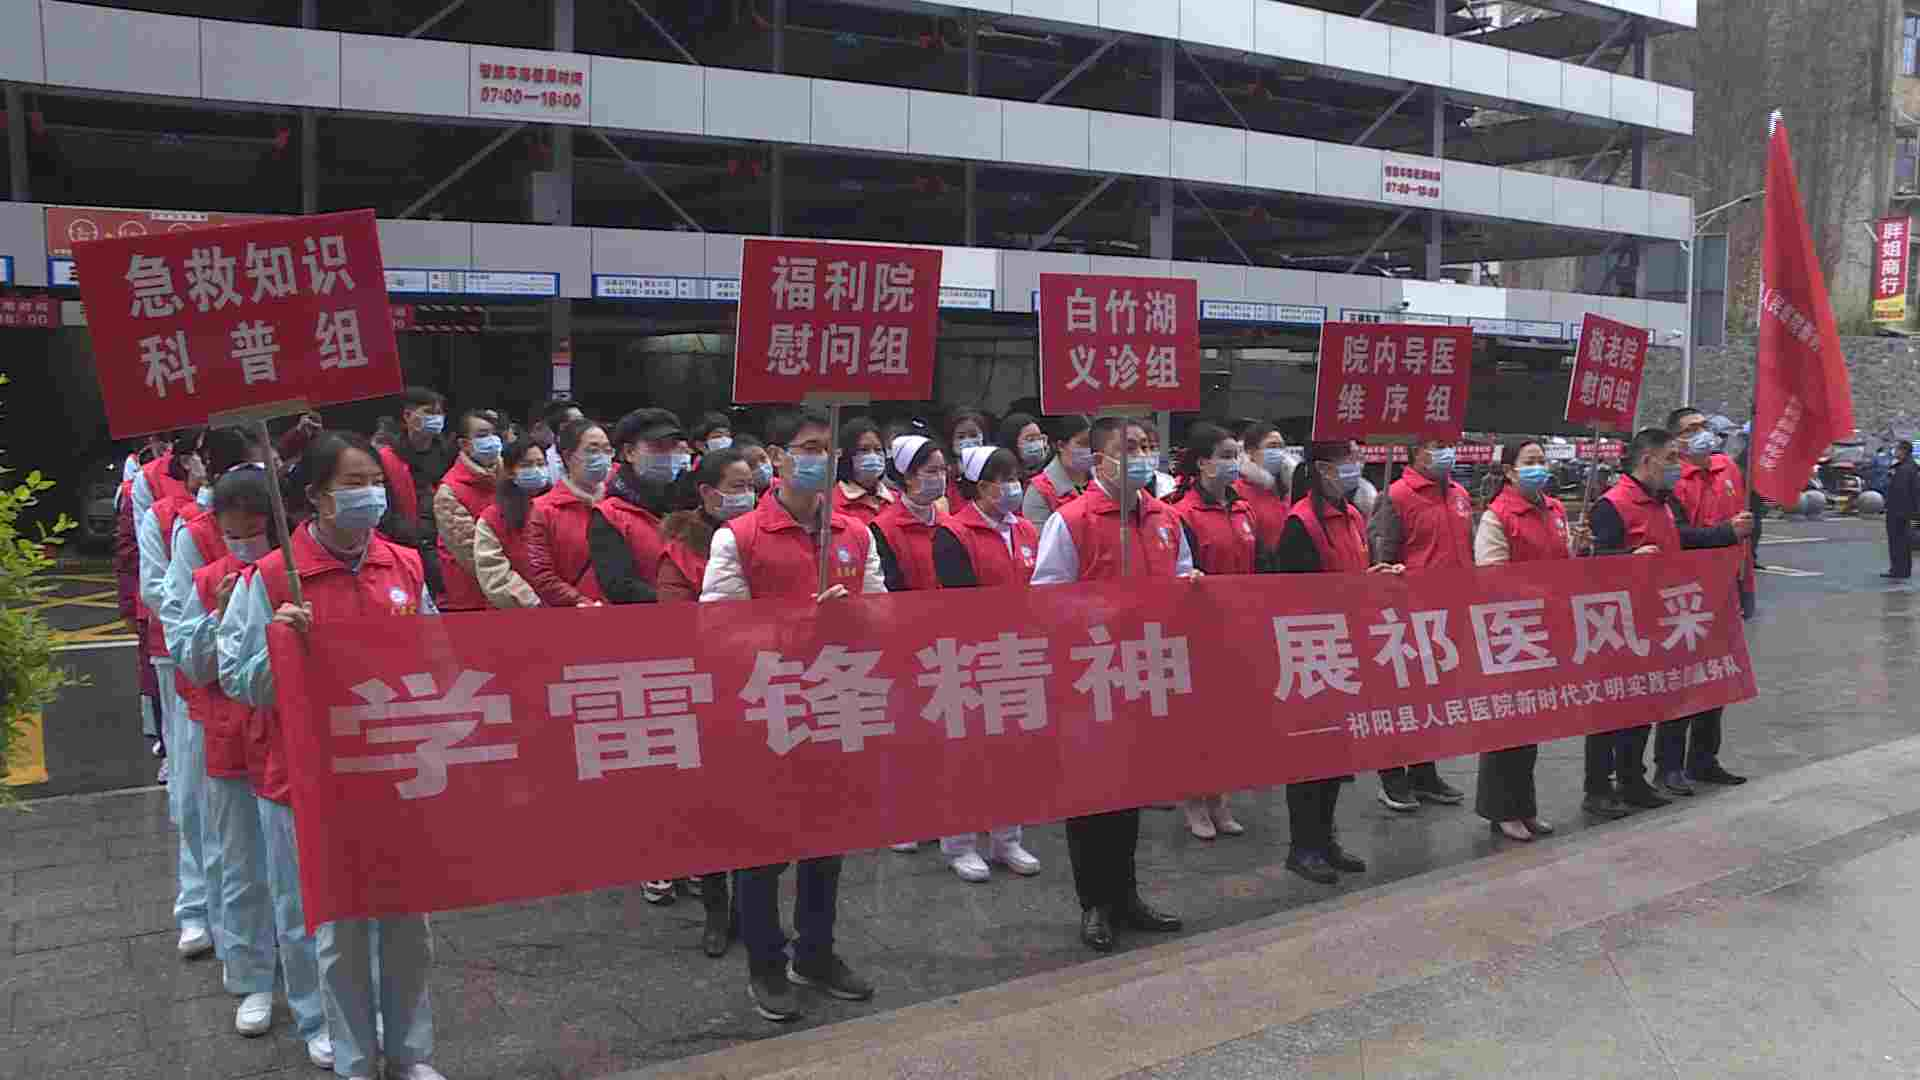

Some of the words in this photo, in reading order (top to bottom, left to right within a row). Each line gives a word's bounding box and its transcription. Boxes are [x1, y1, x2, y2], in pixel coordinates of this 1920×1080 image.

[125, 235, 355, 318] 急救知识
[771, 255, 915, 312] 福利院
[1066, 288, 1178, 335] 白竹湖
[138, 308, 369, 398] 科普组
[765, 323, 909, 375] 慰问组
[1064, 344, 1180, 390] 义诊组
[1341, 334, 1457, 375] 院内导医
[1587, 327, 1640, 371] 敬老院
[1336, 383, 1452, 423] 维序组
[1579, 371, 1633, 413] 慰问组
[329, 621, 1193, 800] 学雷锋精神
[1272, 582, 1717, 702] 展祁医风采
